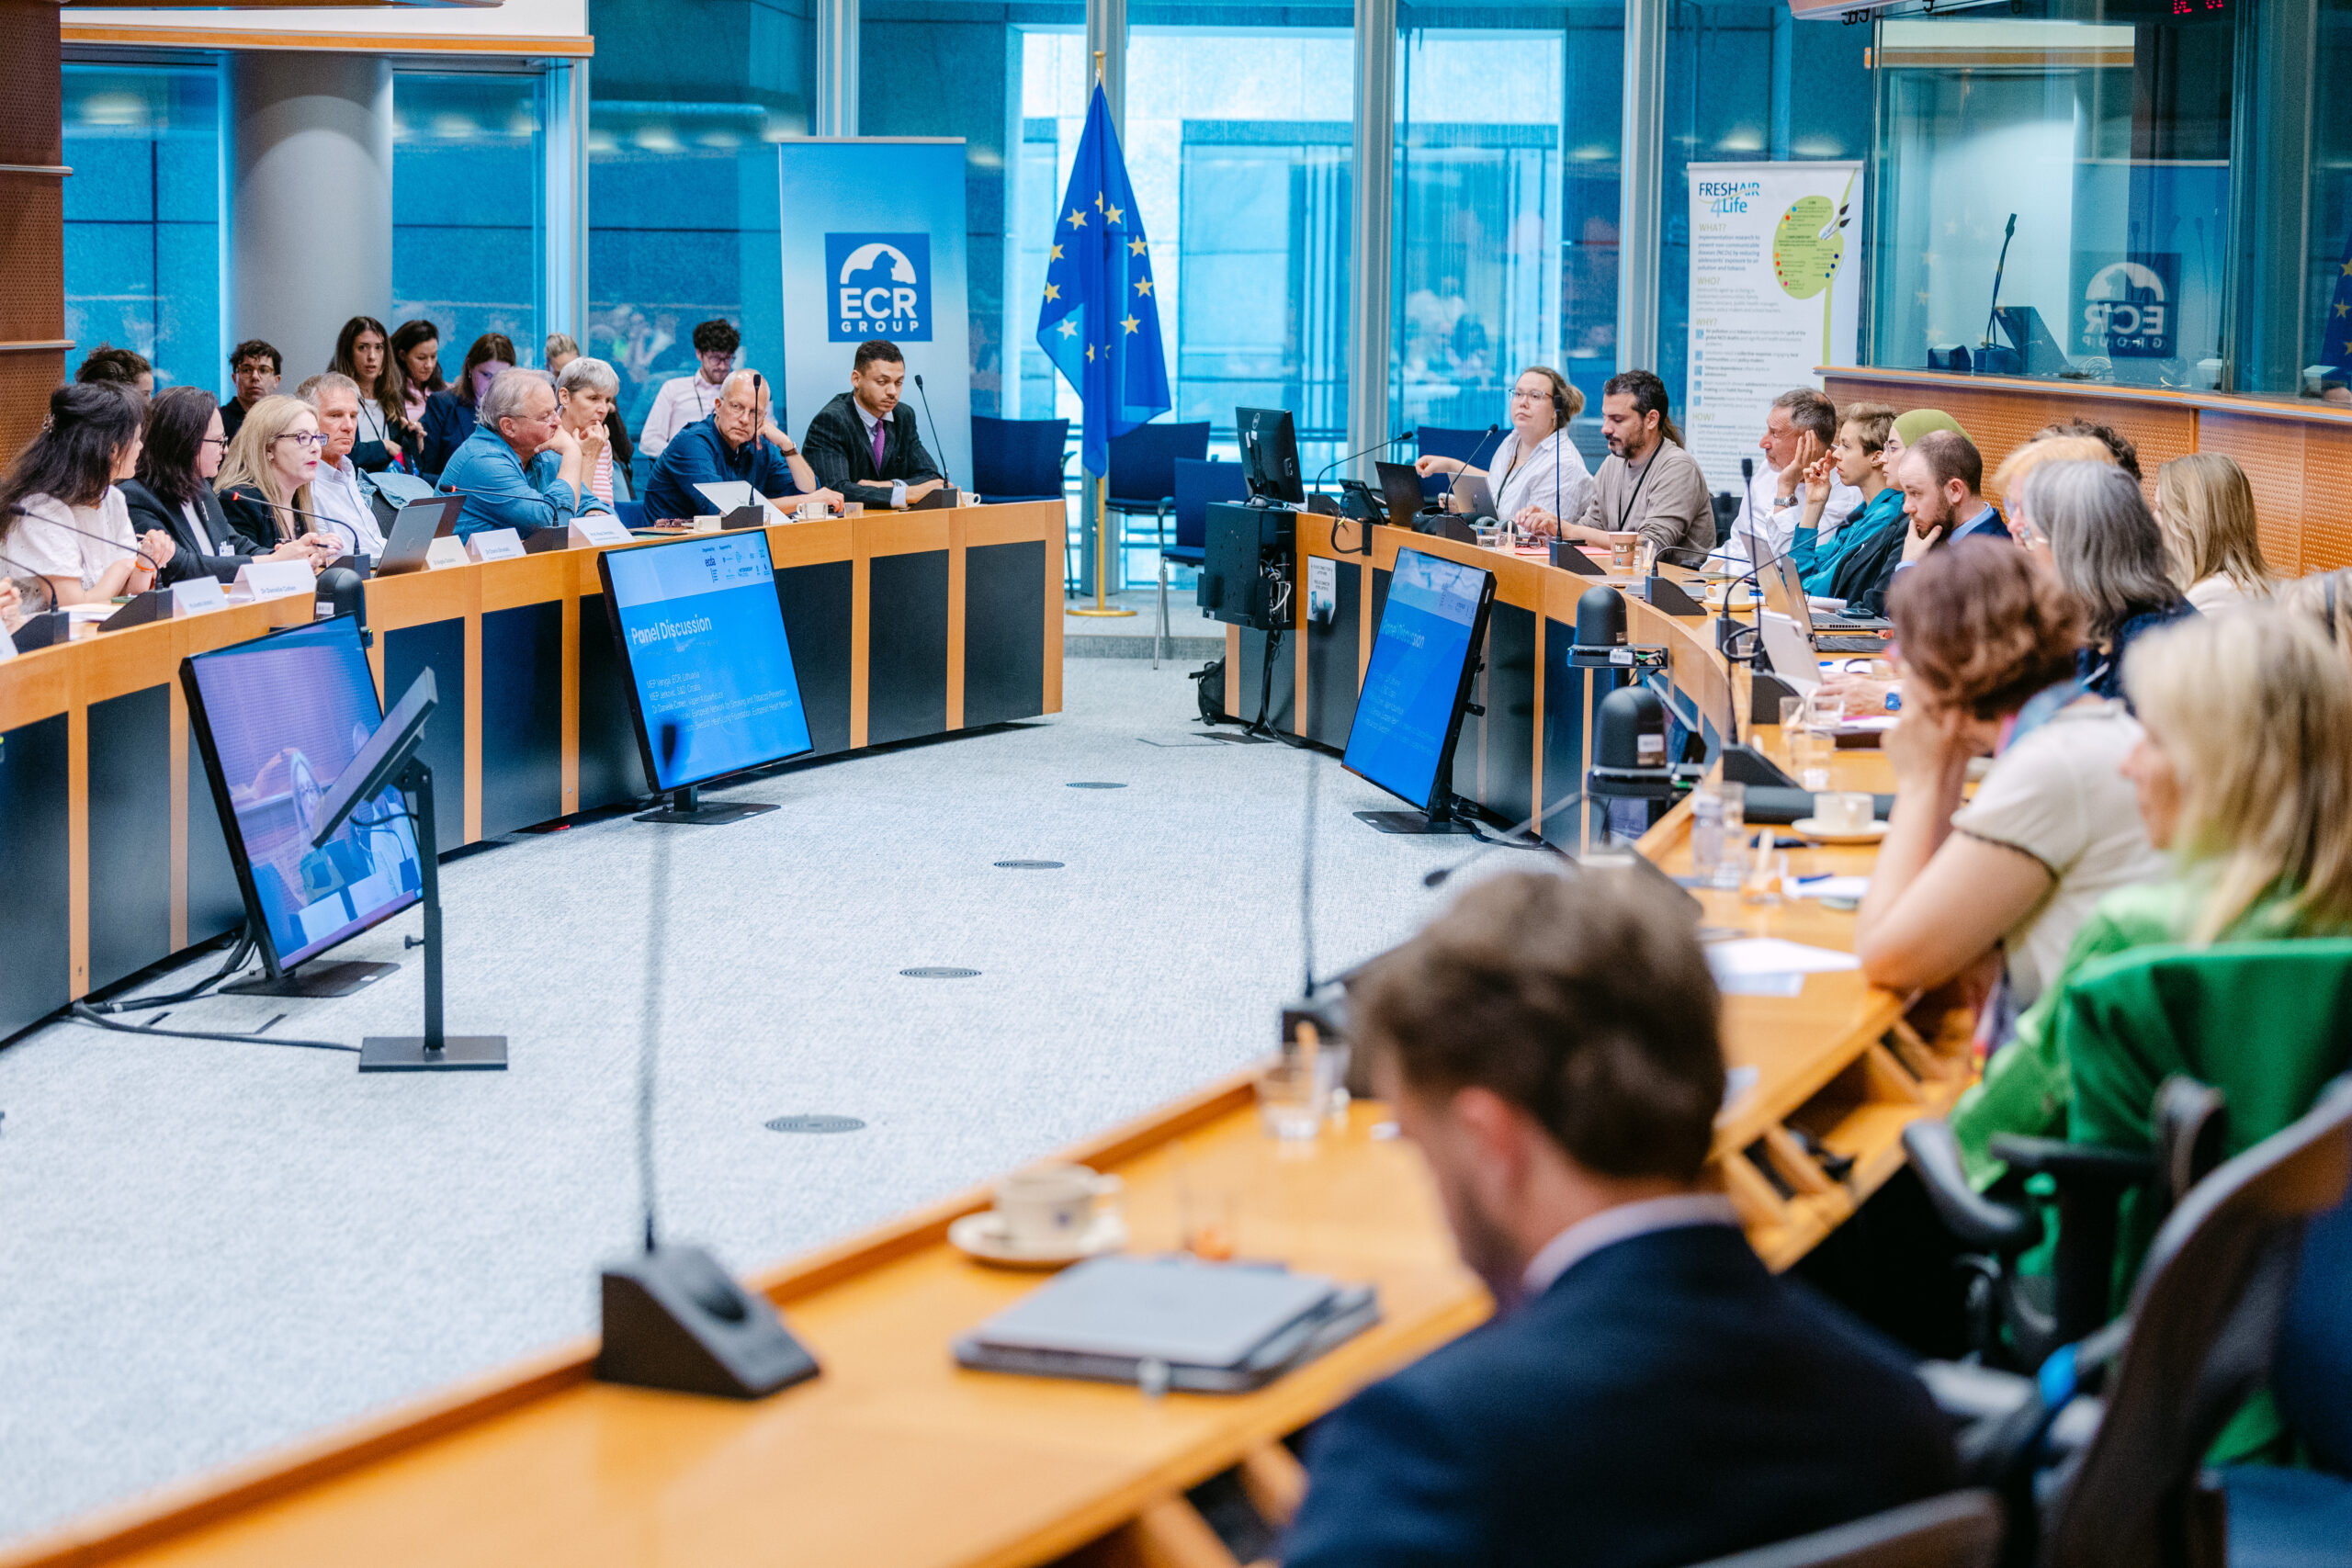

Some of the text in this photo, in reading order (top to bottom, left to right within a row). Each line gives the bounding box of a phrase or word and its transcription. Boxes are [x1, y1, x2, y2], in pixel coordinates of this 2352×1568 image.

[1710, 197, 1748, 218] 4Life
[1699, 222, 1727, 232] WHAT?
[1697, 276, 1721, 286] WHO?
[840, 287, 918, 319] ECR
[841, 321, 920, 333] GROUP
[1696, 317, 1718, 326] WHY?
[1692, 412, 1715, 422] HOW?
[630, 614, 713, 646] Panel Discussion
